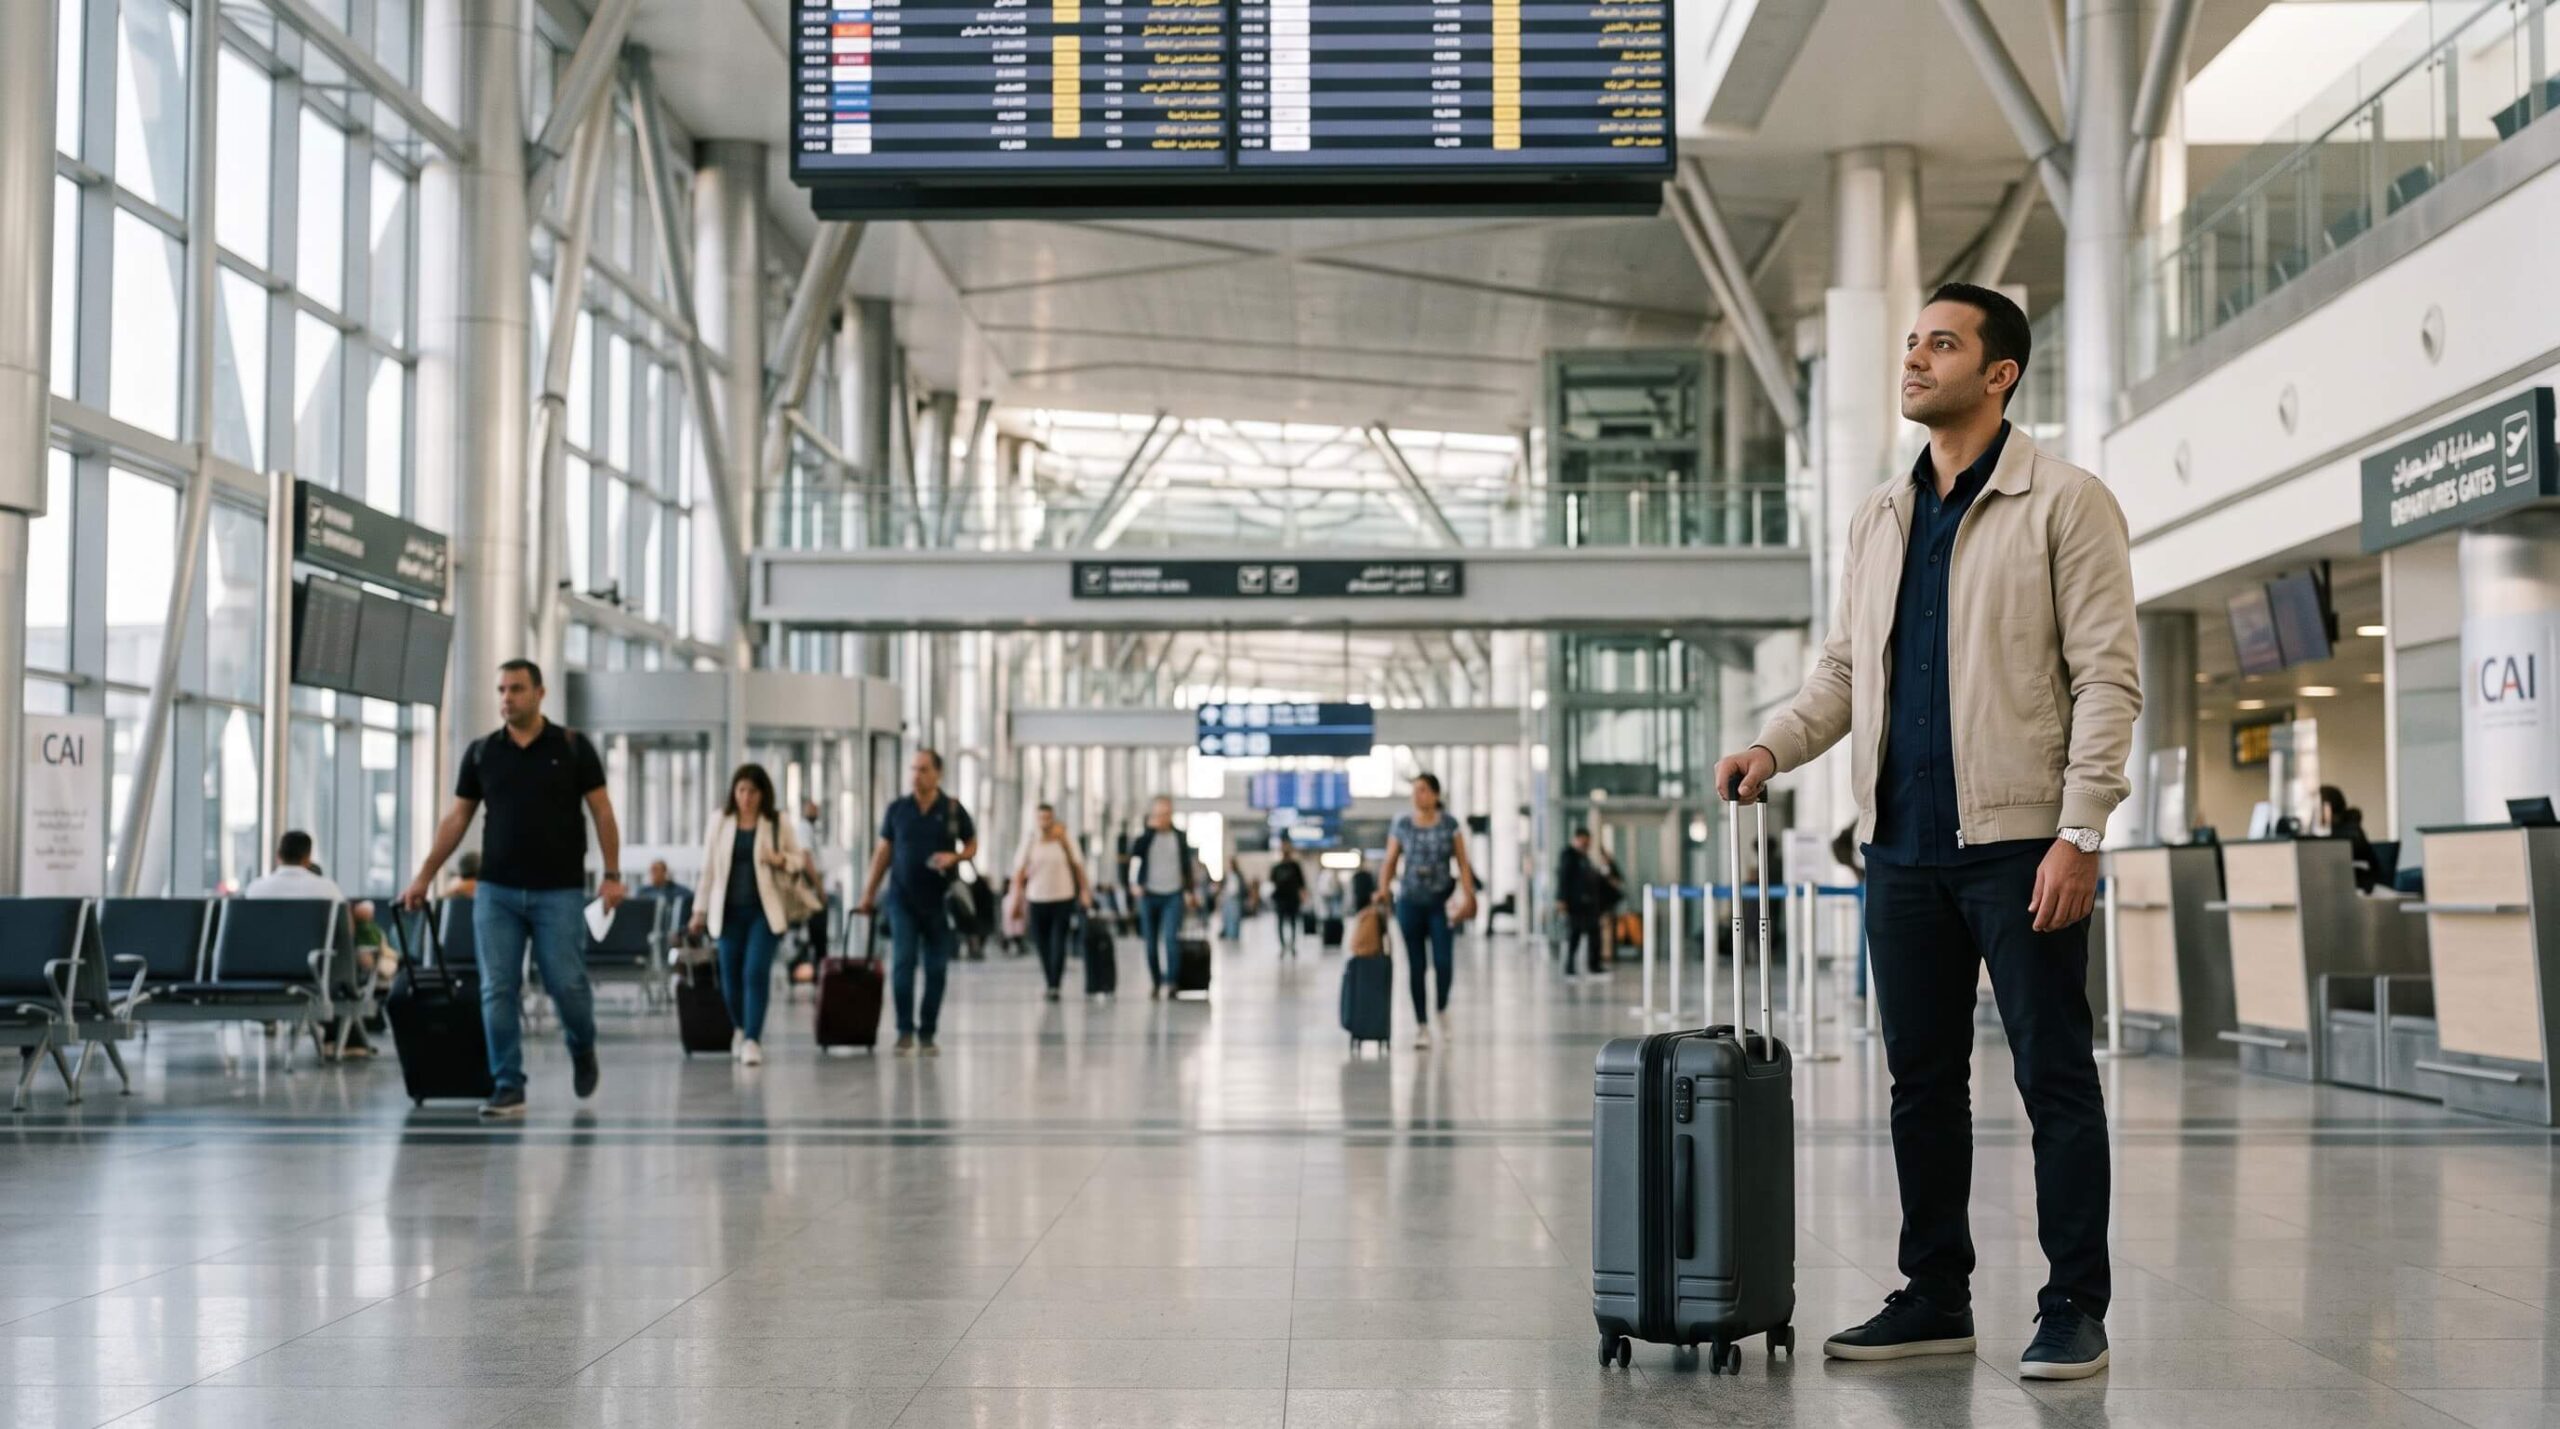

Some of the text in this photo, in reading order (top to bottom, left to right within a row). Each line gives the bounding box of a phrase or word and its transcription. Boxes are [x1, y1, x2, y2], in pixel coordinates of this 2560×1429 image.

[2458, 463, 2497, 503] GATES
[2481, 653, 2536, 702] CAI
[42, 733, 84, 766] CAI
